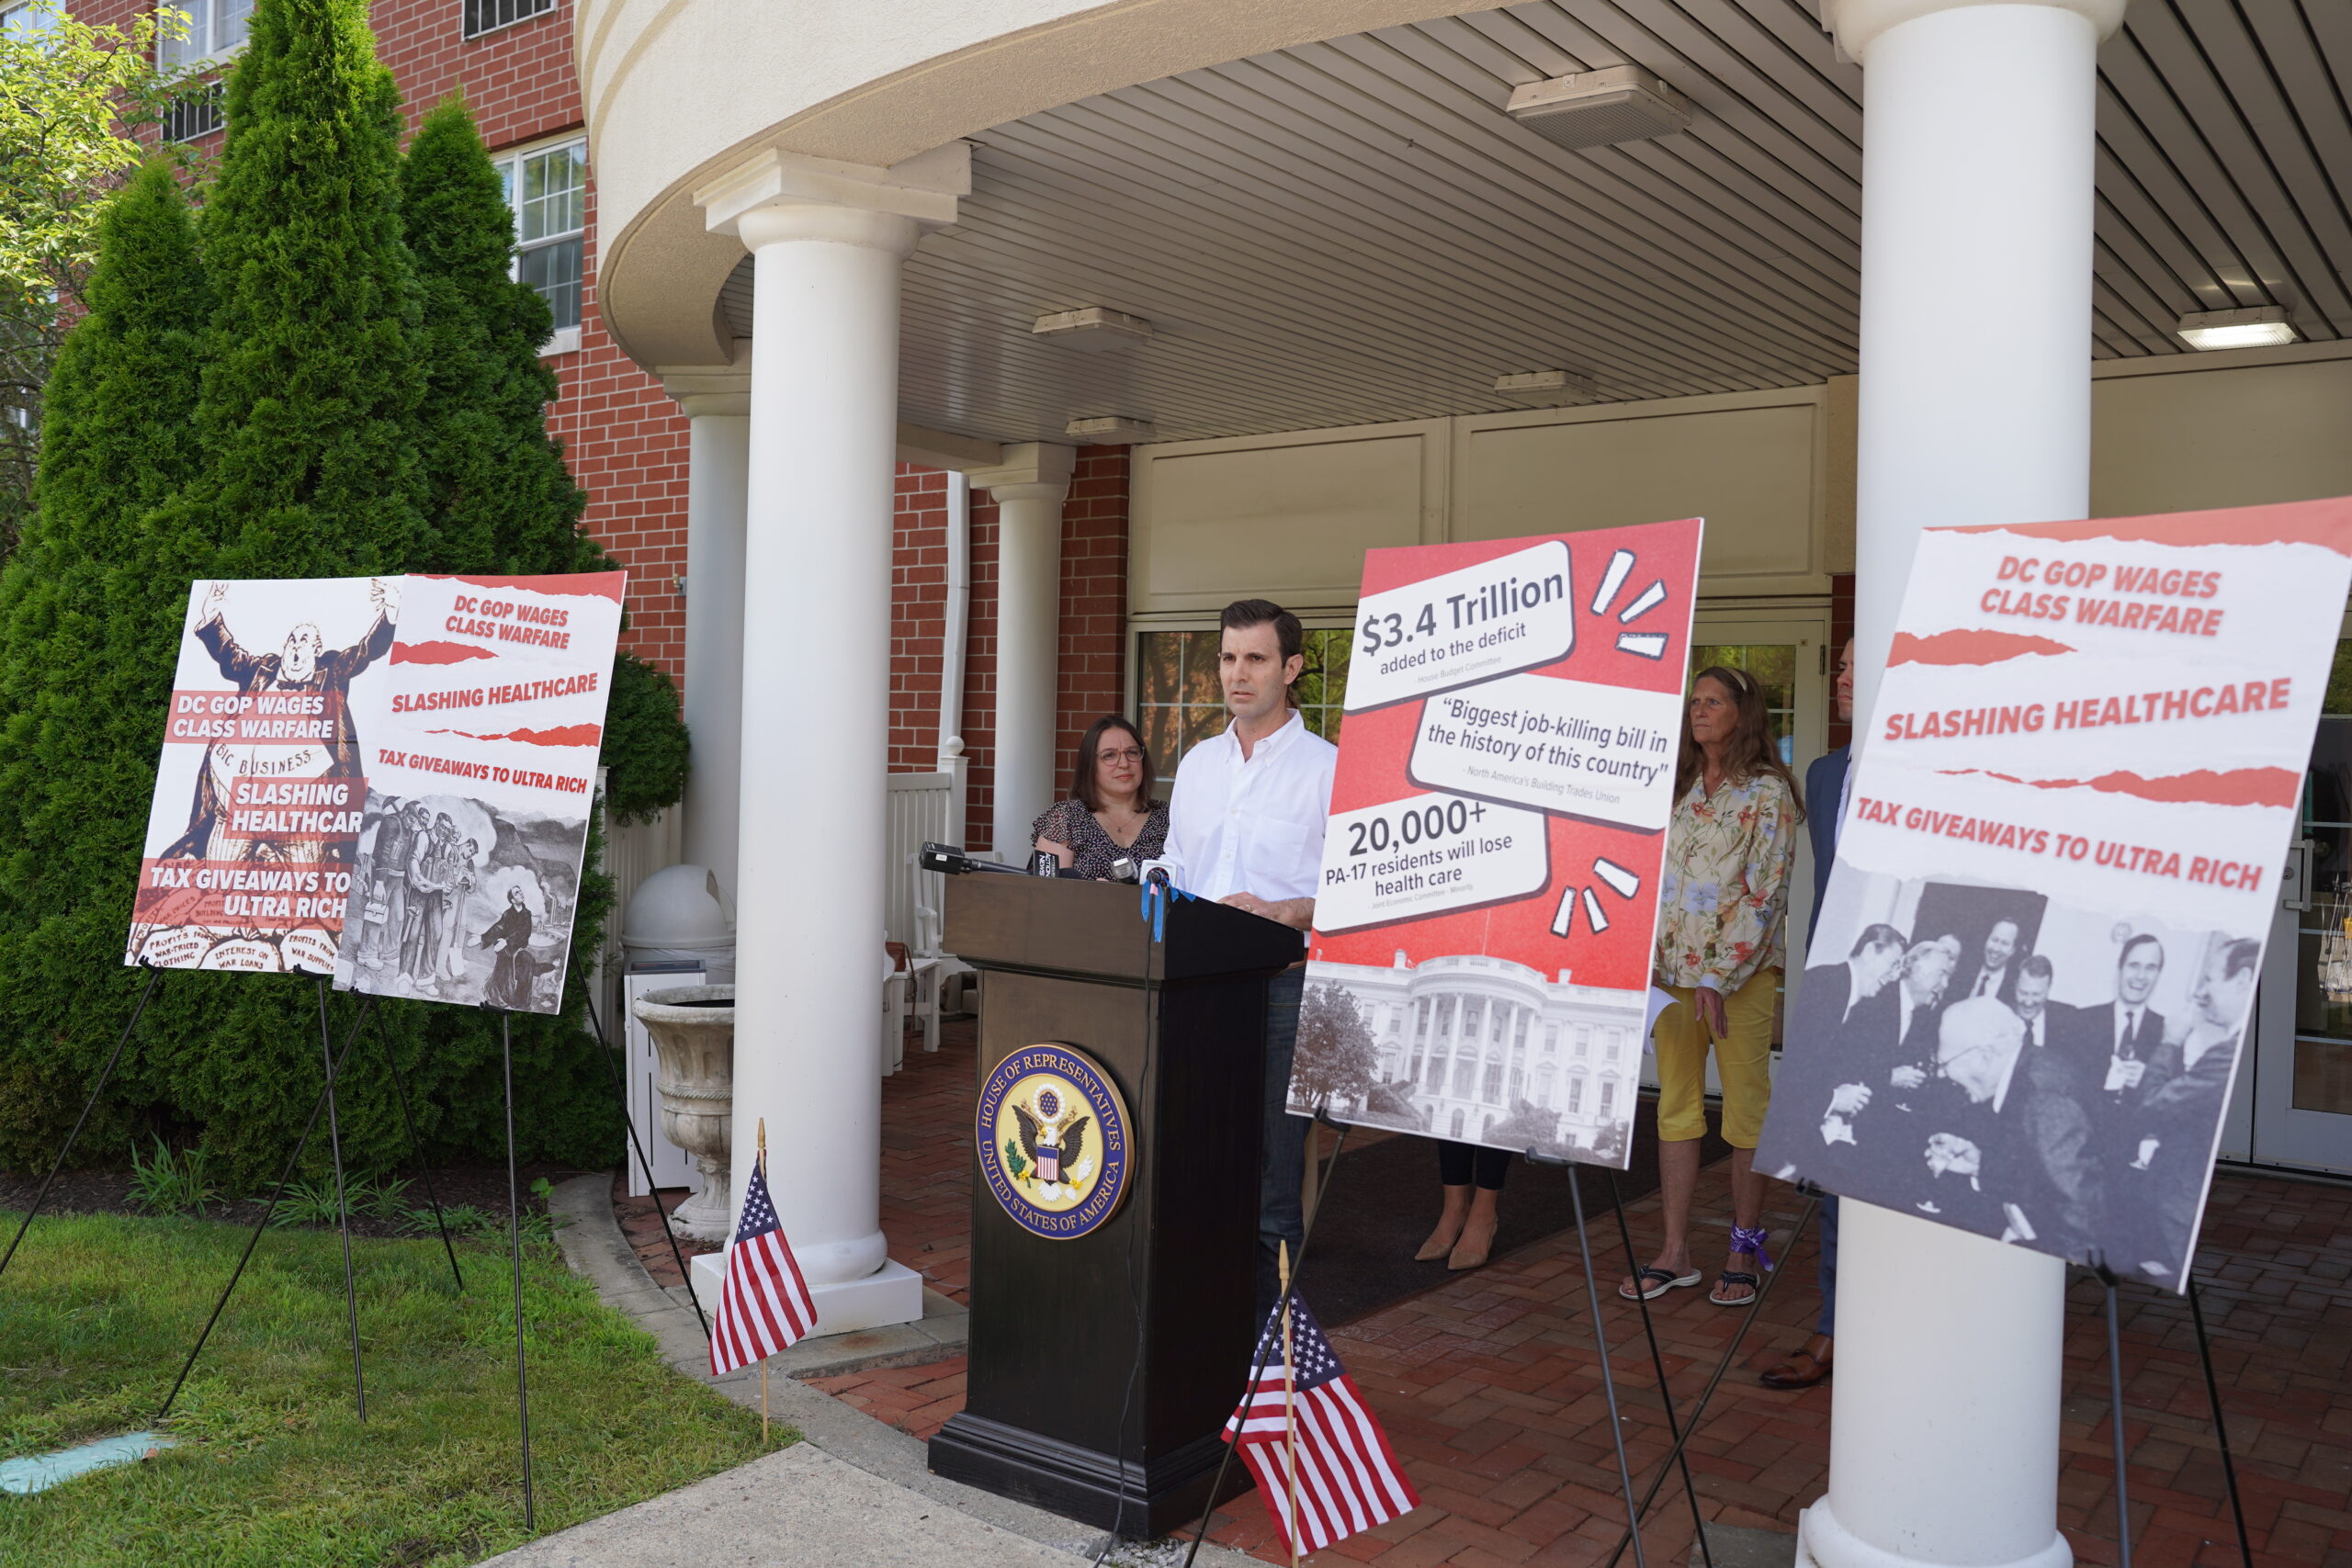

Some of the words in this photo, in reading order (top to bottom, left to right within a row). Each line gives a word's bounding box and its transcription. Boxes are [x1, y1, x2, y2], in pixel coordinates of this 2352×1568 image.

[1996, 555, 2040, 584] DC
[2043, 560, 2107, 590] GOP
[2113, 565, 2222, 599] WAGES
[454, 595, 478, 614] DC
[480, 599, 514, 619] GOP
[516, 604, 570, 627] WAGES
[1362, 603, 1437, 657] $3.4
[1447, 572, 1564, 630] Trillion
[1980, 589, 2071, 622] CLASS
[2075, 597, 2224, 637] WARFARE
[446, 615, 496, 638] CLASS
[498, 624, 571, 649] WARFARE
[1380, 649, 1426, 675] added
[1430, 647, 1445, 661] to
[1450, 631, 1474, 657] the
[1478, 623, 1526, 649] deficit
[1418, 673, 1439, 683] House
[1440, 667, 1464, 680] Budget
[1465, 656, 1502, 671] Committee
[177, 695, 207, 714] DC
[210, 695, 253, 715] GOP
[257, 696, 324, 715] WAGES
[391, 688, 484, 713] SLASHING
[488, 672, 598, 705] HEALTHCARE
[1884, 704, 2045, 741] SLASHING
[2053, 677, 2292, 732] HEALTHCARE
[174, 719, 236, 738] CLASS
[241, 719, 334, 739] WARFARE
[1519, 709, 1612, 749] job-killing
[1617, 726, 1646, 750] bill
[1649, 730, 1668, 753] in
[239, 750, 311, 775] BUSINESS
[1428, 725, 1457, 746] the
[1461, 728, 1521, 762] history
[1525, 740, 1546, 761] of
[1547, 744, 1580, 769] this
[379, 749, 408, 768] TAX
[409, 753, 490, 780] GIVEAWAYS
[492, 767, 511, 783] TO
[512, 770, 553, 790] ULTRA
[555, 775, 588, 795] RICH
[1467, 766, 1489, 779] North
[1491, 771, 1530, 787] America's
[1531, 777, 1564, 795] Building
[1566, 784, 1593, 798] Trades
[1595, 791, 1620, 804] Union
[235, 783, 349, 806] SLASHING
[232, 810, 364, 833] HEALTHCAR
[1348, 799, 1487, 857] 20,000+
[1326, 863, 1367, 886] PA-17
[1371, 850, 1443, 877] residents
[1447, 838, 1476, 863] will
[1479, 833, 1513, 855] lose
[1855, 796, 1903, 827] TAX
[1905, 807, 2049, 855] GIVEAWAYS
[2054, 834, 2089, 860] TO
[2094, 840, 2181, 878] ULTRA
[2188, 858, 2263, 892] RICH
[151, 867, 193, 888] TAX
[196, 868, 320, 893] GIVEAWAYS
[324, 872, 351, 893] TO
[1374, 873, 1424, 897] health
[1429, 868, 1463, 886] care
[1414, 889, 1446, 902] Committee
[1450, 884, 1474, 896] Minority
[223, 896, 291, 918] ULTRA
[296, 897, 347, 919] RICH
[150, 932, 188, 951] PROFITS
[215, 946, 255, 960] INTEREST
[258, 952, 269, 960] ON
[289, 935, 316, 946] PROFITS
[319, 942, 335, 960] FROM
[292, 948, 306, 958] WAR
[153, 952, 195, 967] CLOTHING
[219, 958, 236, 969] WAR
[240, 958, 264, 970] LOANS
[981, 1077, 1008, 1130] HOUSE
[1004, 1060, 1022, 1079] OF
[1023, 1054, 1121, 1152] REPRESENTATIVES
[983, 1138, 1012, 1202] UNITED
[1010, 1198, 1058, 1231] STATES
[1059, 1215, 1079, 1231] OF
[1080, 1160, 1119, 1226] AMERICA
